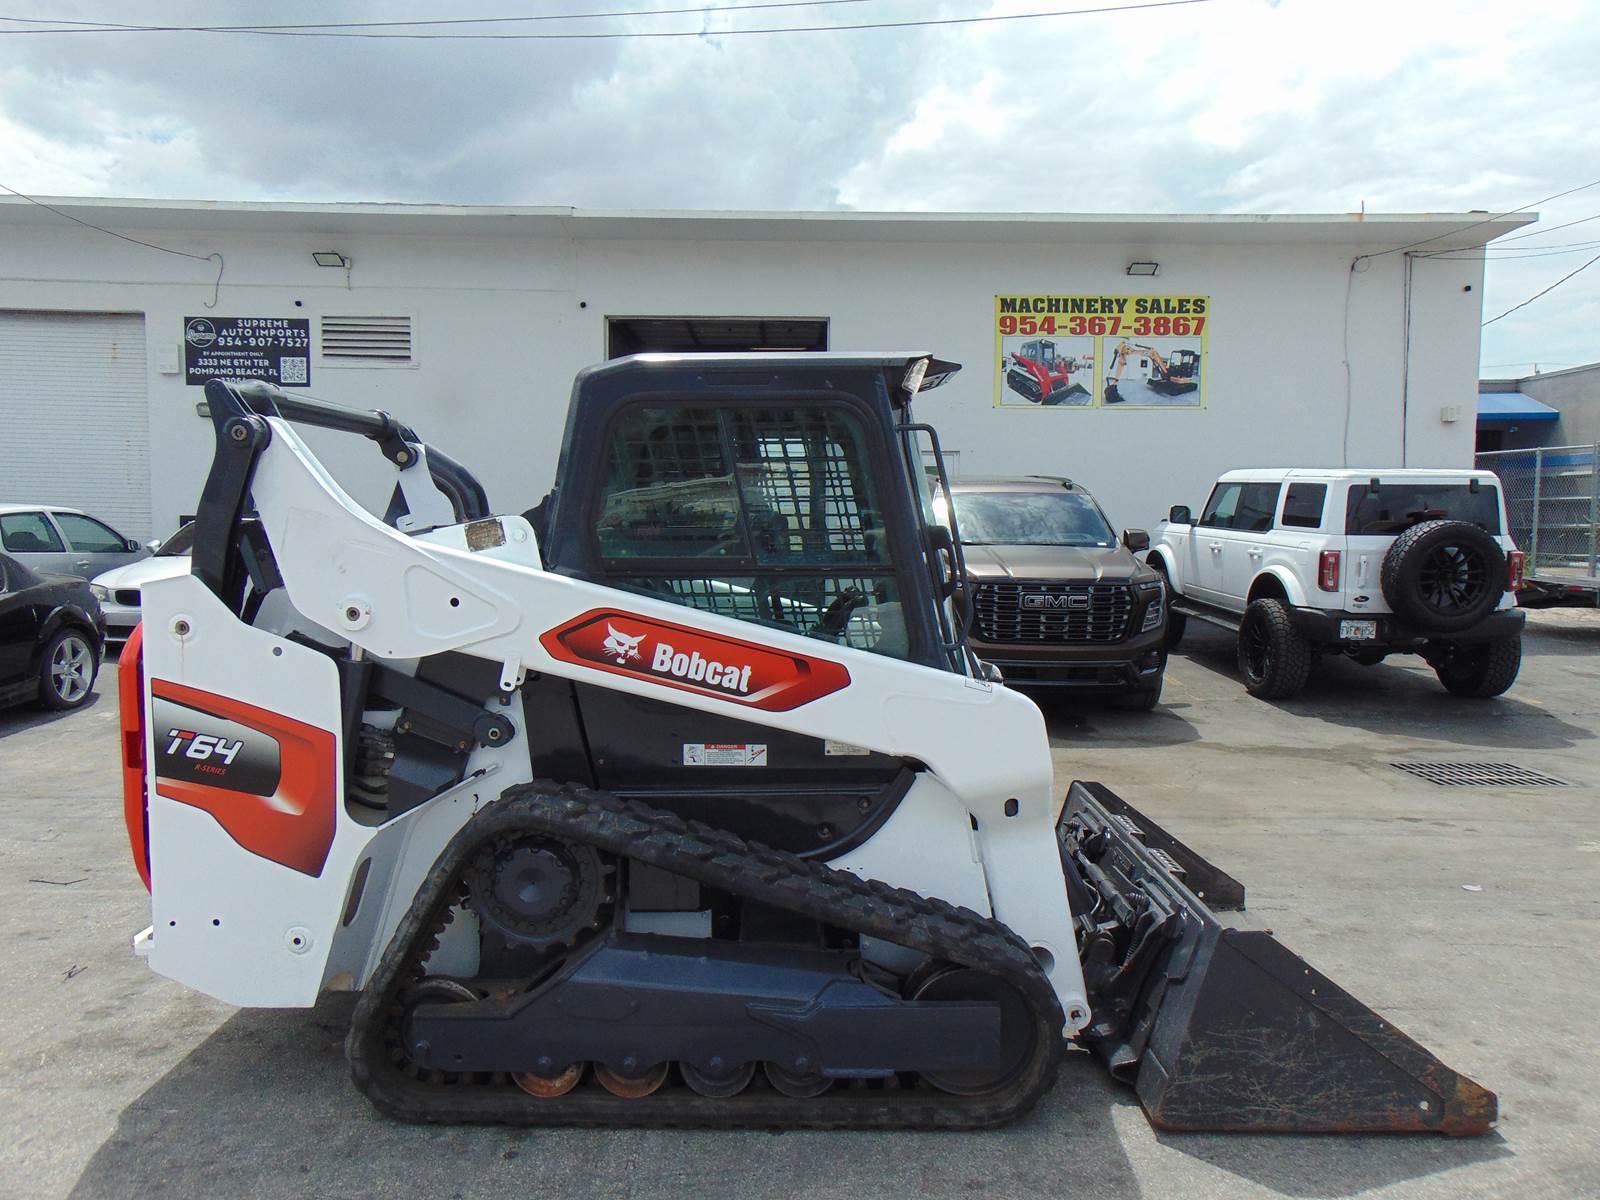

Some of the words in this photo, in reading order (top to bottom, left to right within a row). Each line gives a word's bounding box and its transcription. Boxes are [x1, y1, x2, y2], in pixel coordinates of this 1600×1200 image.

[1000, 298, 1128, 314] MACHINERY
[1135, 298, 1206, 314] SALES
[237, 319, 289, 328] SUPREME
[999, 315, 1206, 336] 954-367-3867
[221, 328, 252, 337] AUTO
[256, 329, 306, 337] IMPORTS
[217, 337, 308, 347] 954-907-7527
[197, 358, 218, 366] 3333
[220, 358, 231, 366] NE
[234, 359, 252, 367] 6TH
[253, 359, 270, 367] TER
[189, 367, 233, 375] POMPANO
[236, 367, 267, 377] BEACH,
[268, 368, 278, 376] FL
[1024, 594, 1089, 608] GMC
[651, 642, 752, 693] Bobcat
[166, 728, 245, 765] T64
[194, 763, 227, 776] R-SERIES
